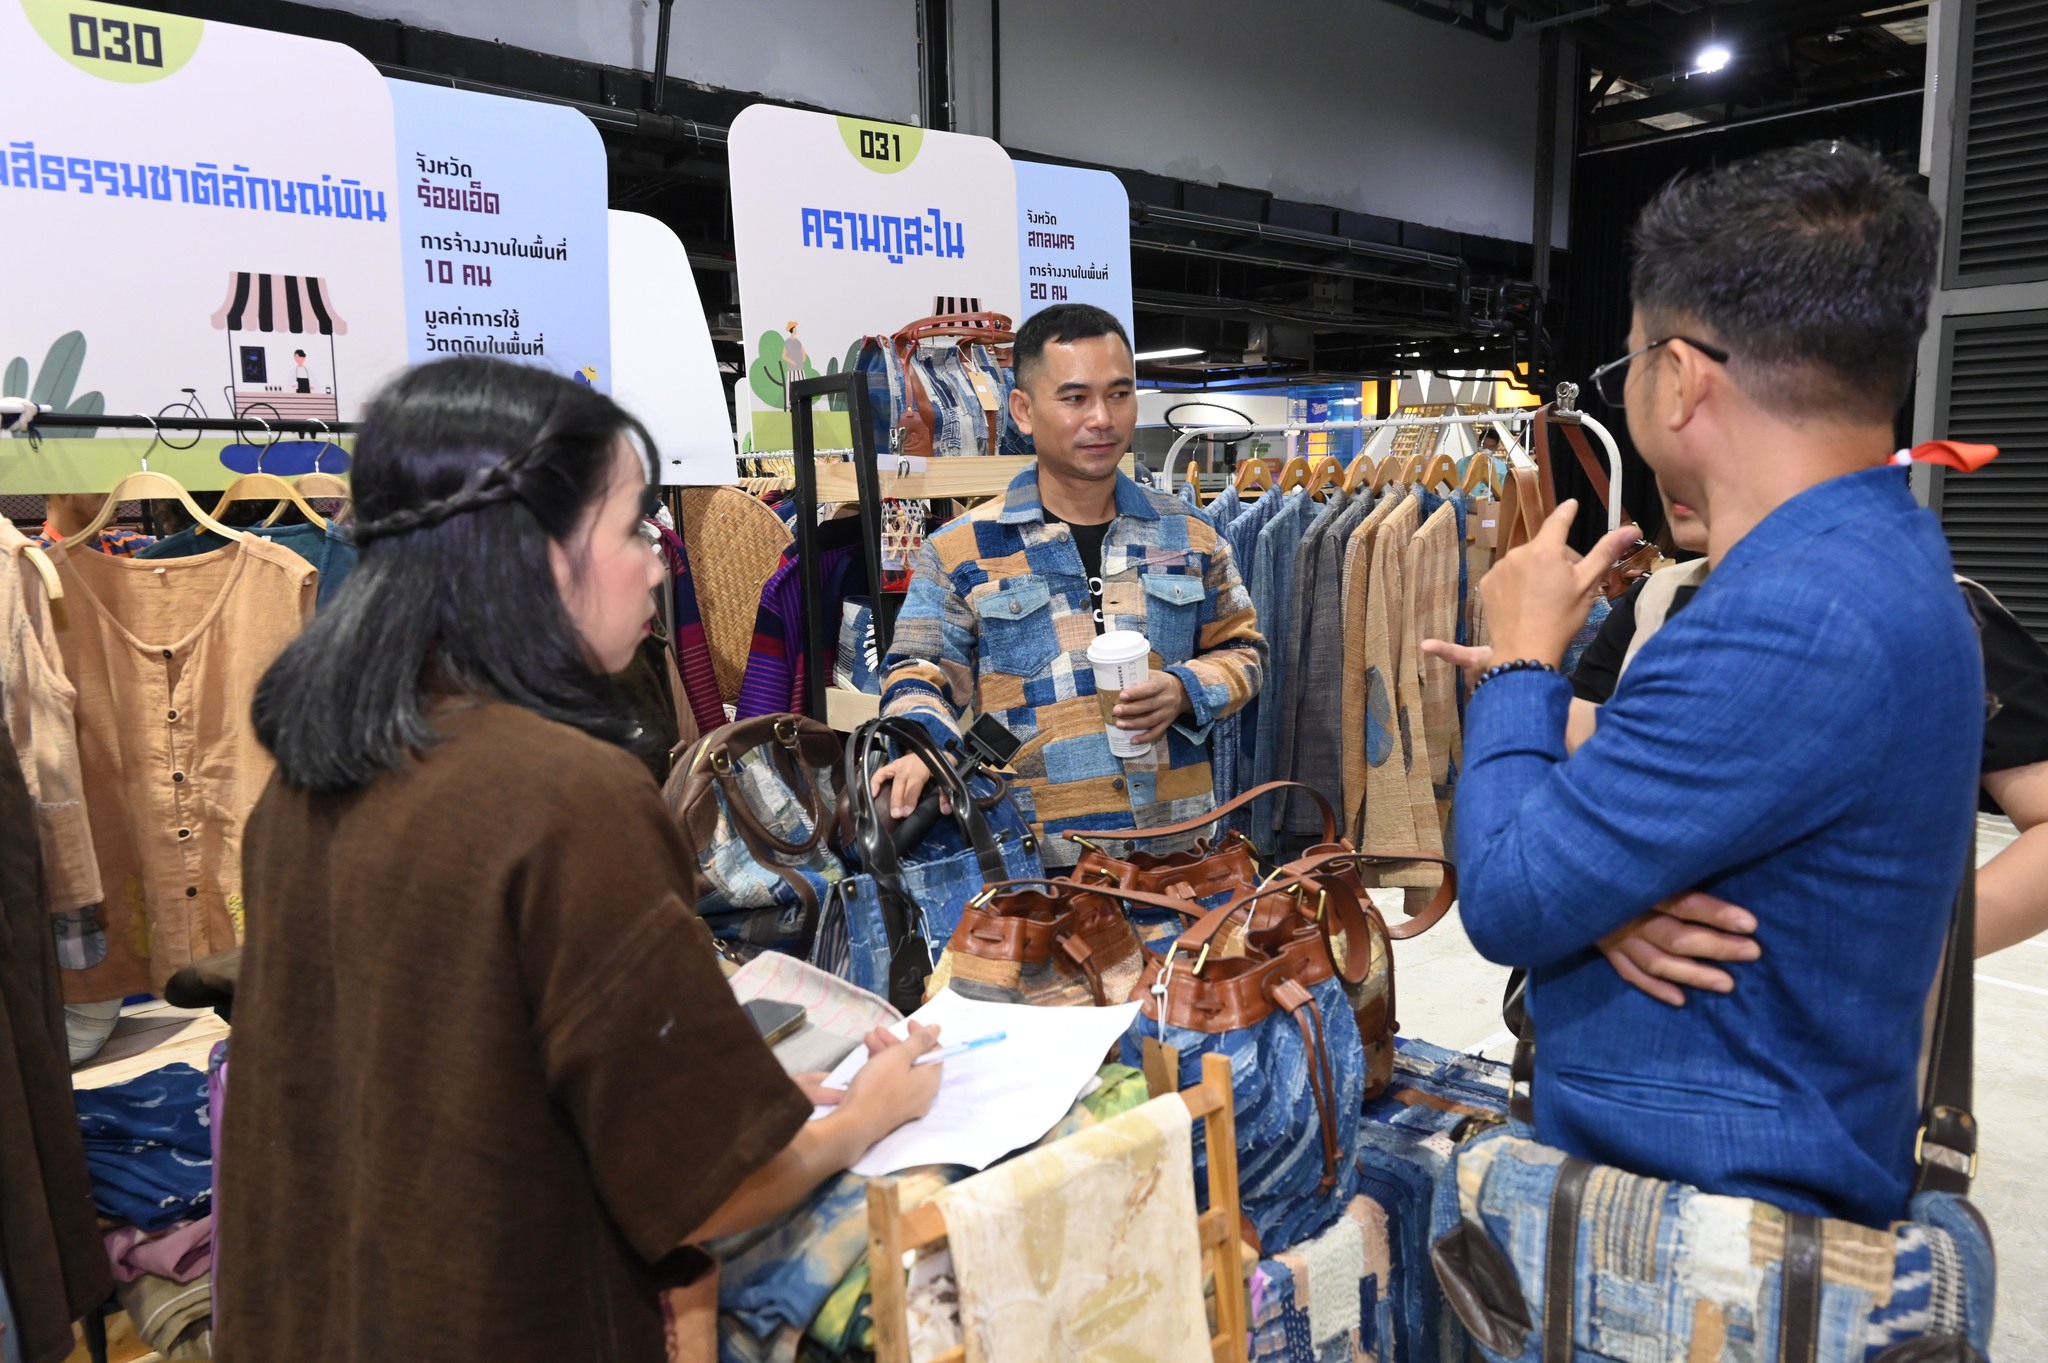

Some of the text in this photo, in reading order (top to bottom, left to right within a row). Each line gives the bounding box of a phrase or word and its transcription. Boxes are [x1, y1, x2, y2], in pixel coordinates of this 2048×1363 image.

[69, 13, 163, 68] 030
[859, 129, 900, 162] 031
[416, 152, 472, 178] จังหวัด
[417, 177, 500, 215] ร้อยเอ็ด
[1027, 209, 1057, 225] จังหวัด
[420, 231, 567, 261] การจ้างงานในพื้นที่
[1028, 231, 1075, 250] สกลนคร
[425, 259, 492, 287] 10 คน
[1029, 262, 1109, 280] การจ้างงานในพื้นที่
[1030, 282, 1068, 301] 20 คน
[425, 306, 520, 329] มูลค่าการใช้
